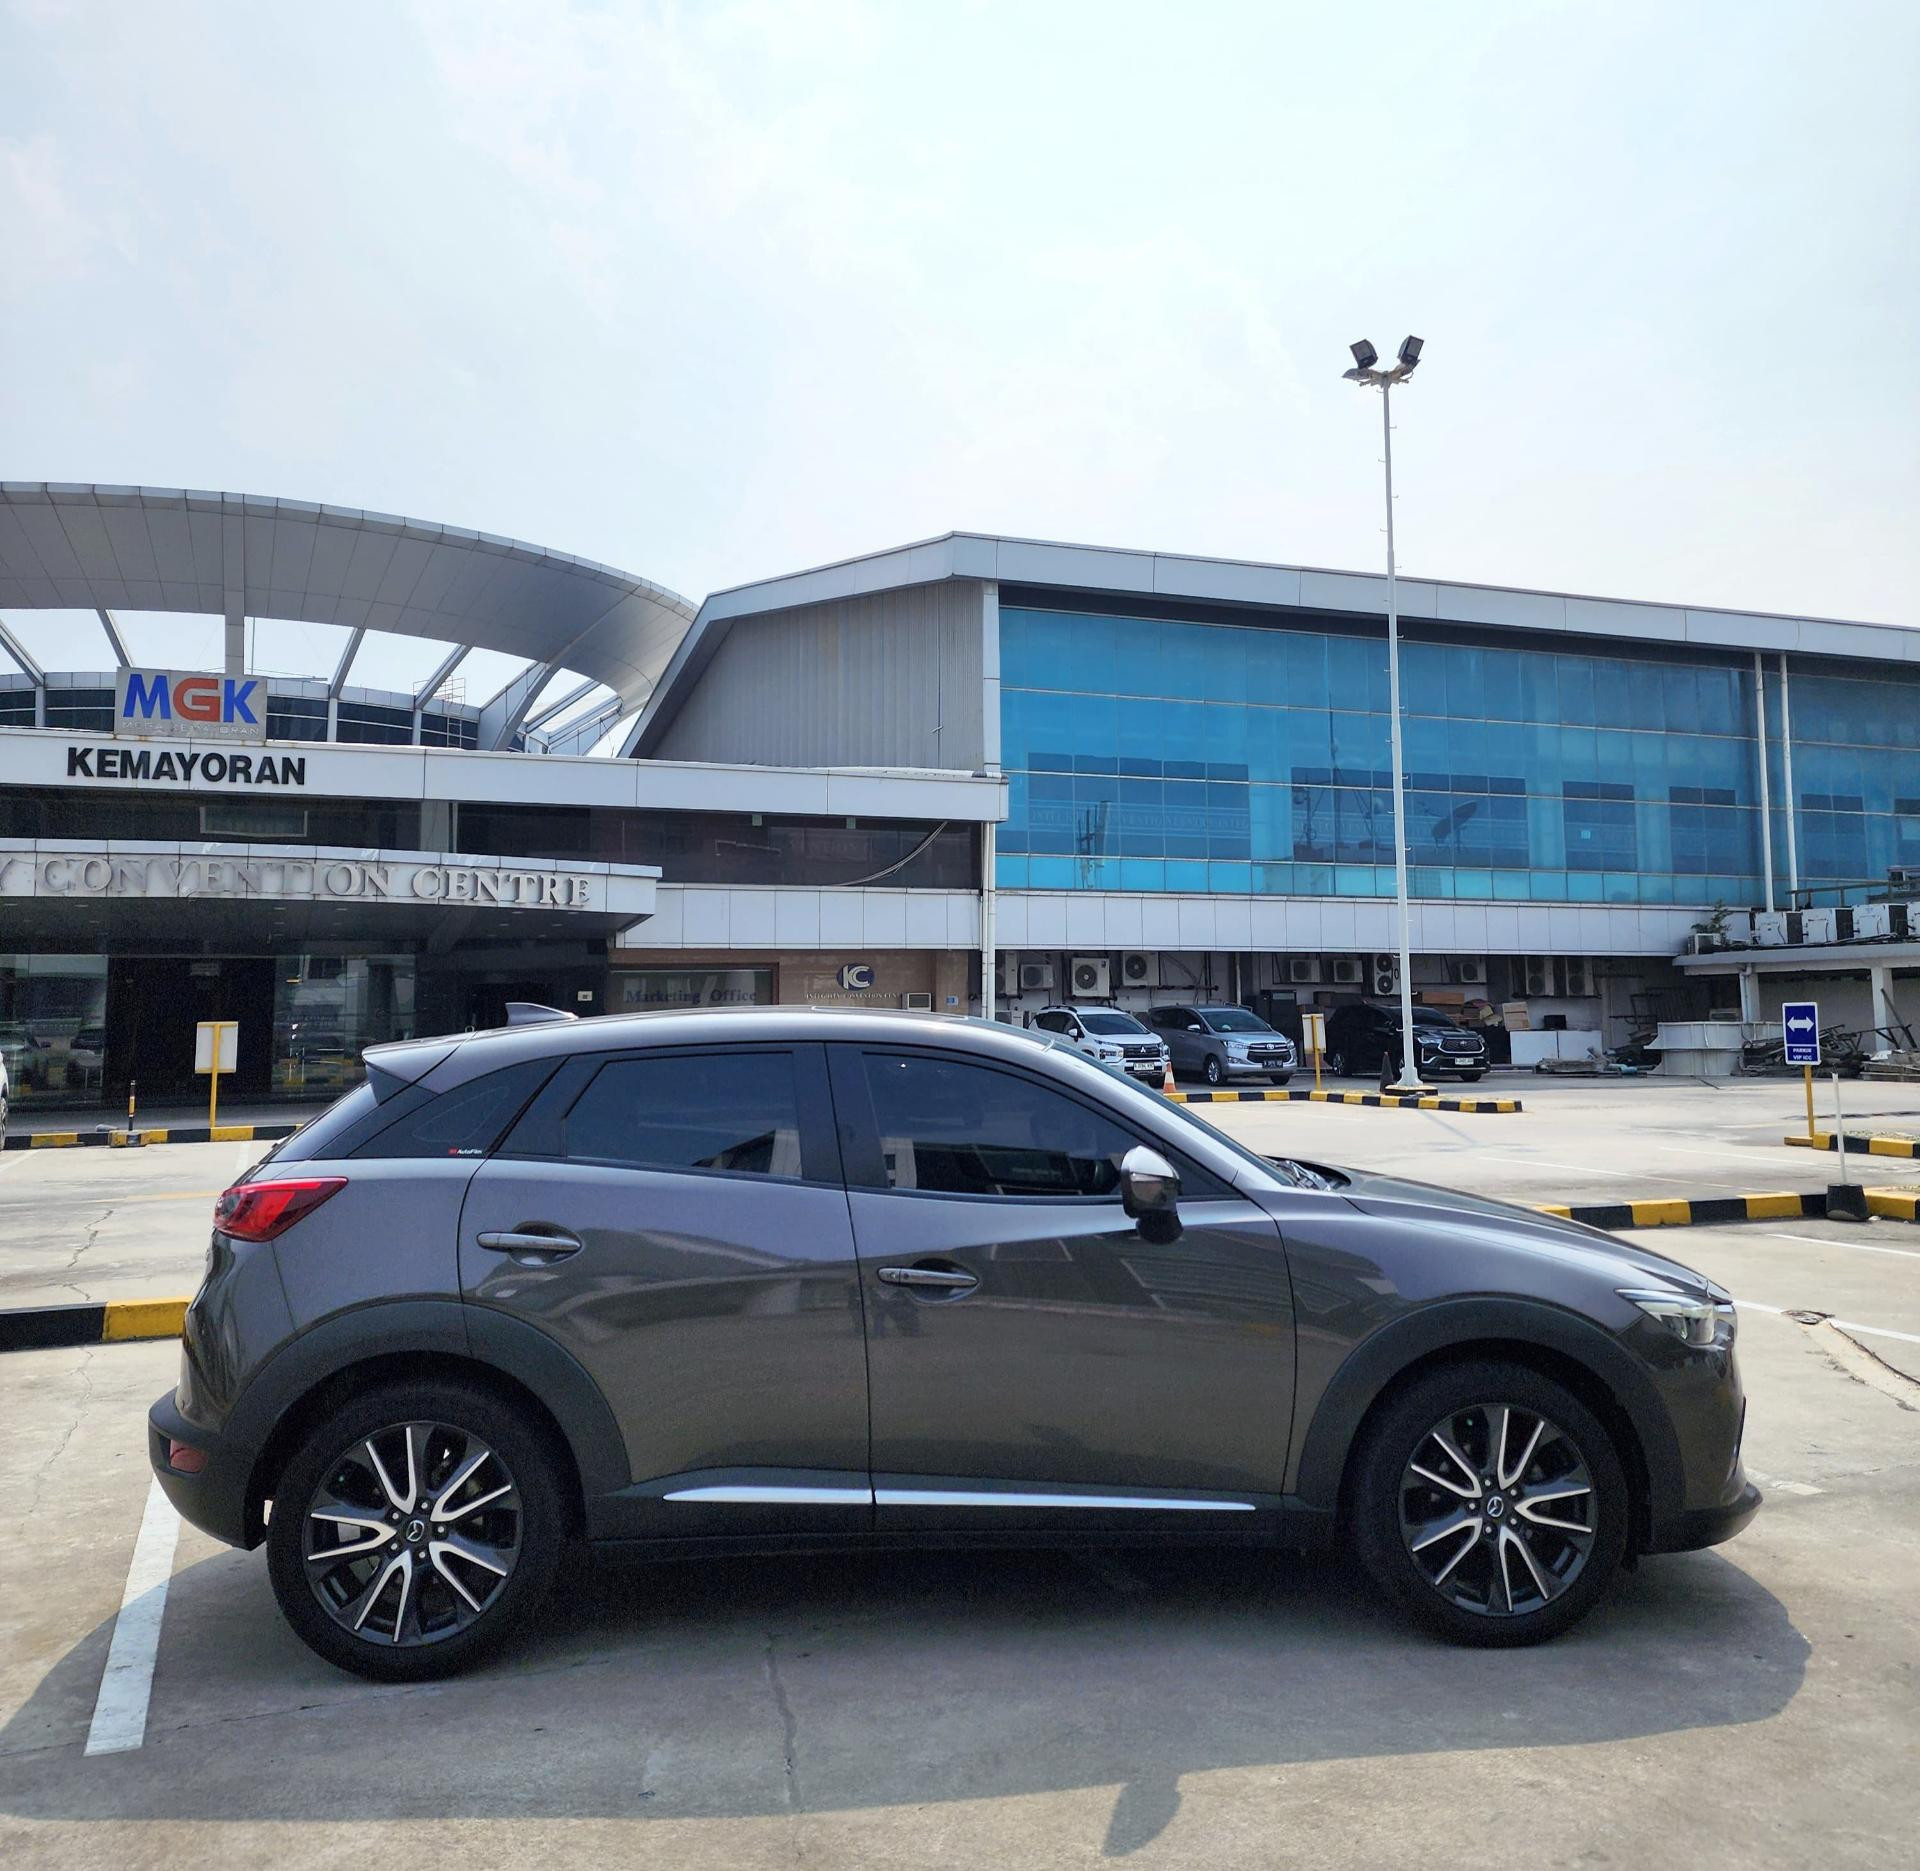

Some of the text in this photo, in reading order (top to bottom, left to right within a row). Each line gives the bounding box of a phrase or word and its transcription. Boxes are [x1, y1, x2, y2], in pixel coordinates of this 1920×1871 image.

[122, 673, 258, 724] MGK
[67, 747, 305, 785] KEMAYORAN
[44, 859, 398, 897] CONVENTION
[412, 867, 592, 906] CENTRE
[626, 988, 757, 1004] Marketing Office
